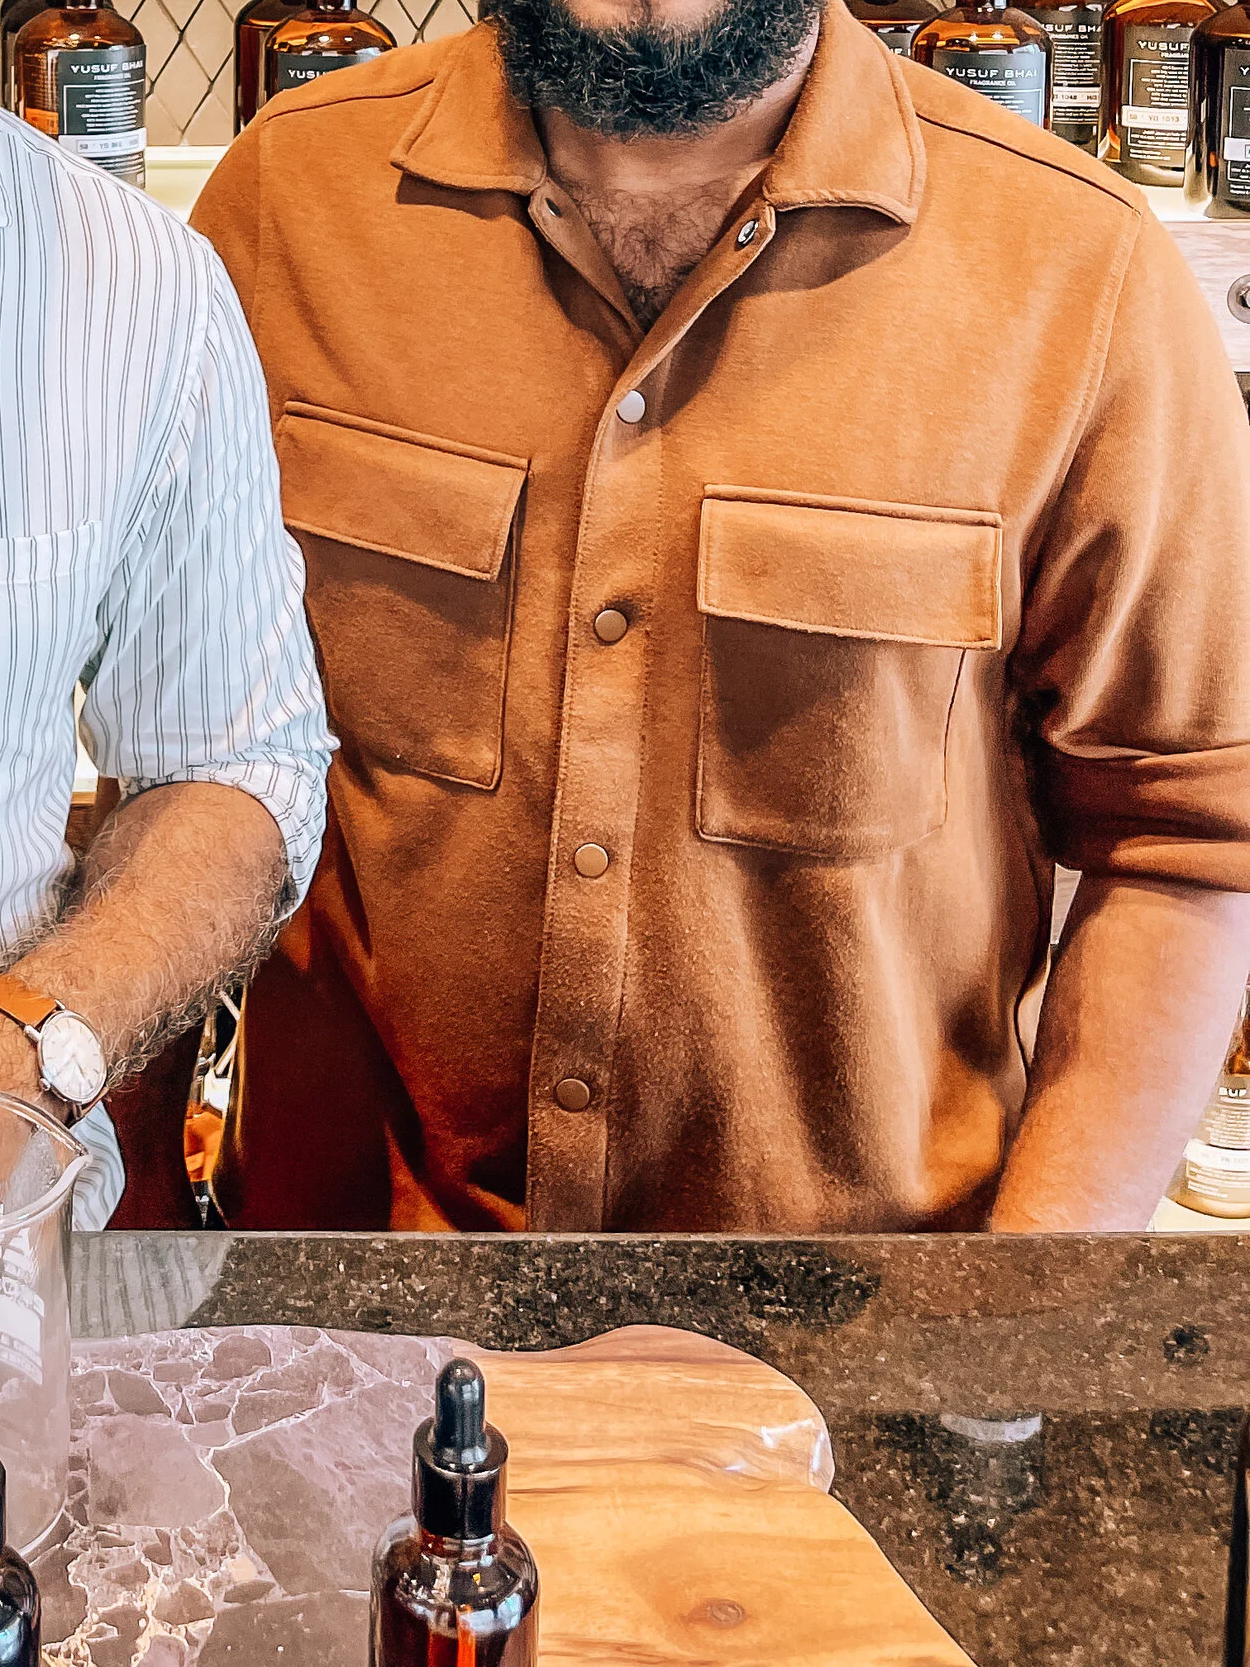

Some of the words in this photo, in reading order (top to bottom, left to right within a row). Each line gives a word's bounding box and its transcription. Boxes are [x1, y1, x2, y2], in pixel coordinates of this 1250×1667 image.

[1138, 40, 1190, 50] YUSUF
[70, 64, 118, 74] YUSUF
[122, 60, 144, 71] BHAI
[288, 70, 326, 79] YUS
[946, 67, 999, 78] YUSUF
[1004, 68, 1038, 78] BHAI
